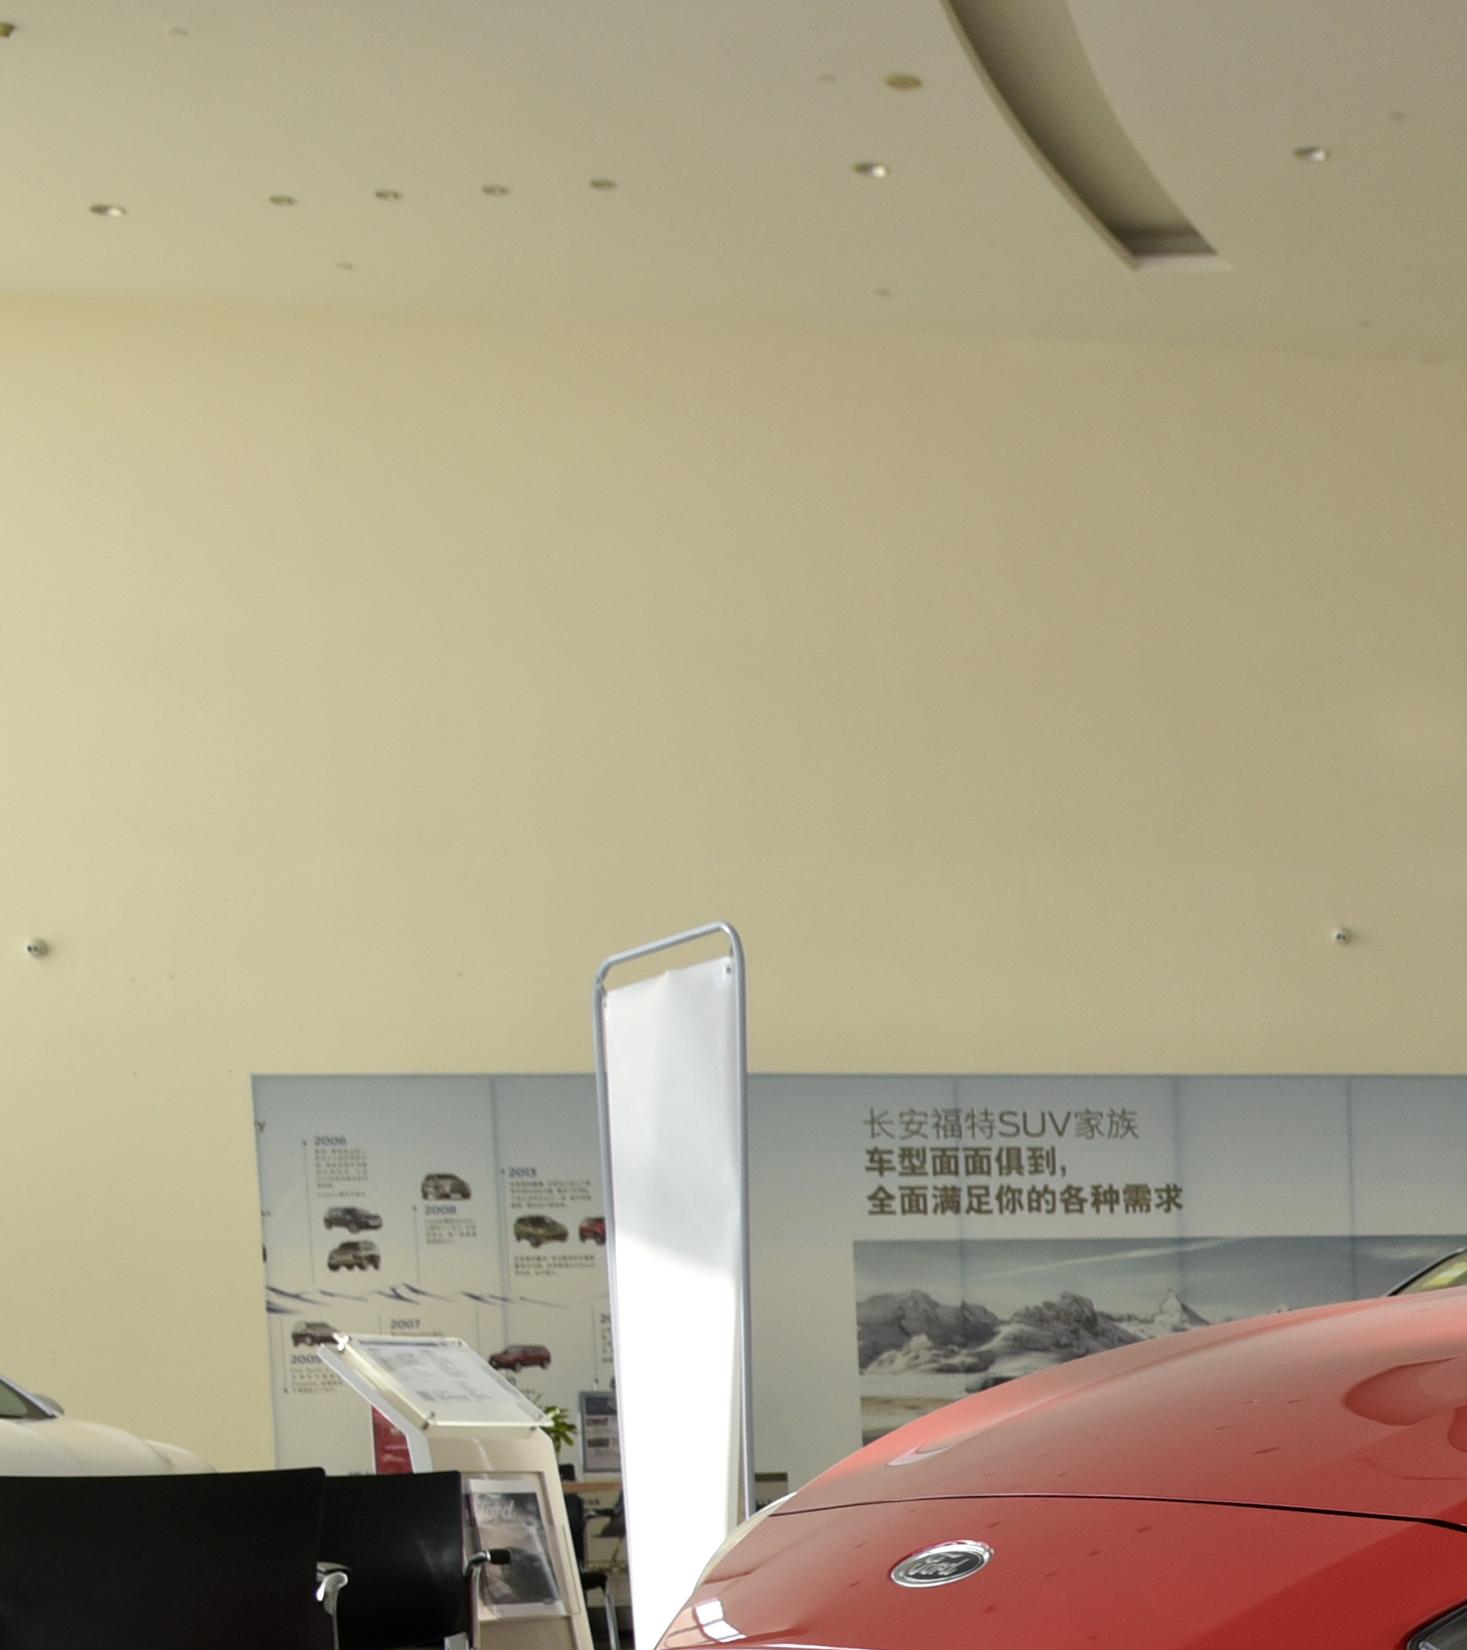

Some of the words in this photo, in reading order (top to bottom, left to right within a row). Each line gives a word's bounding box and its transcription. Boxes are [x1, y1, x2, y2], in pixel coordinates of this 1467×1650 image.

[862, 1107, 1140, 1141] 长安福特SUV家族
[866, 1183, 1184, 1217] 全面满足你的各种需求
[908, 1551, 970, 1576] Ford
